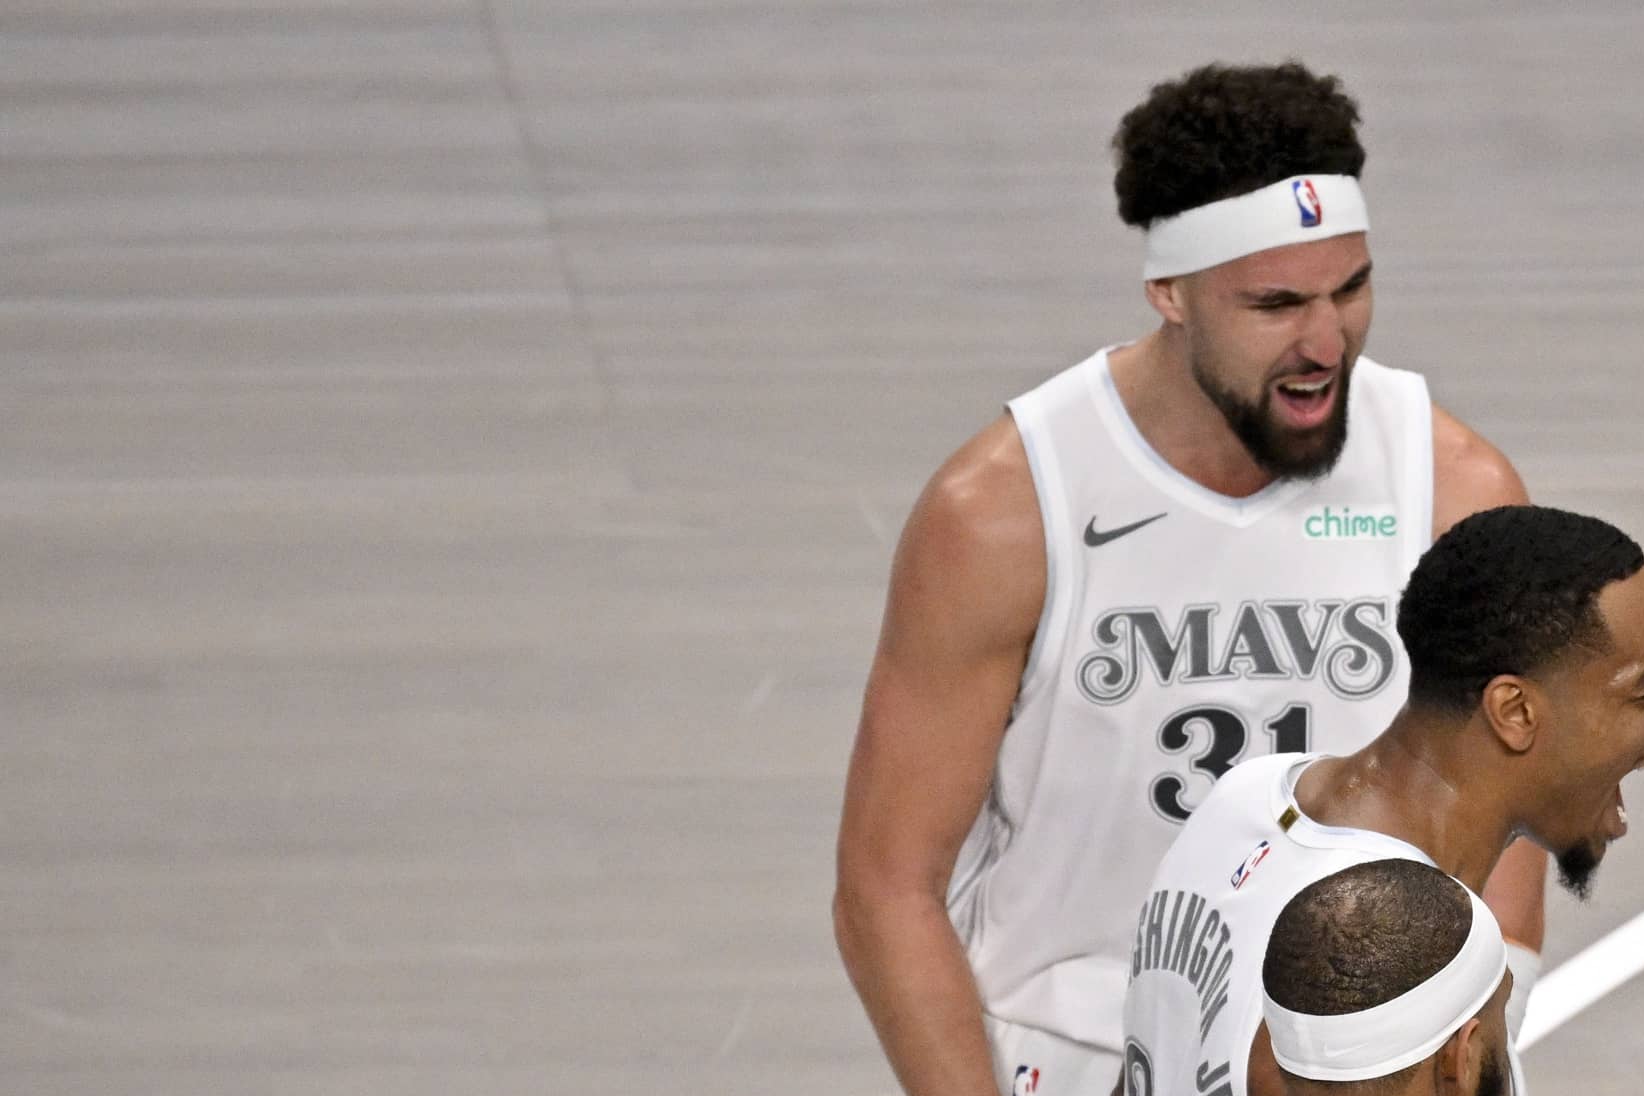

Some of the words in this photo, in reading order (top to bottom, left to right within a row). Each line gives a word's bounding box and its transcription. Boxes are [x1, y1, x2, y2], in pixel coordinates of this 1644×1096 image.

[1305, 507, 1397, 538] chime
[1075, 596, 1400, 706] MAVS
[1128, 889, 1235, 1048] SHINGTON
